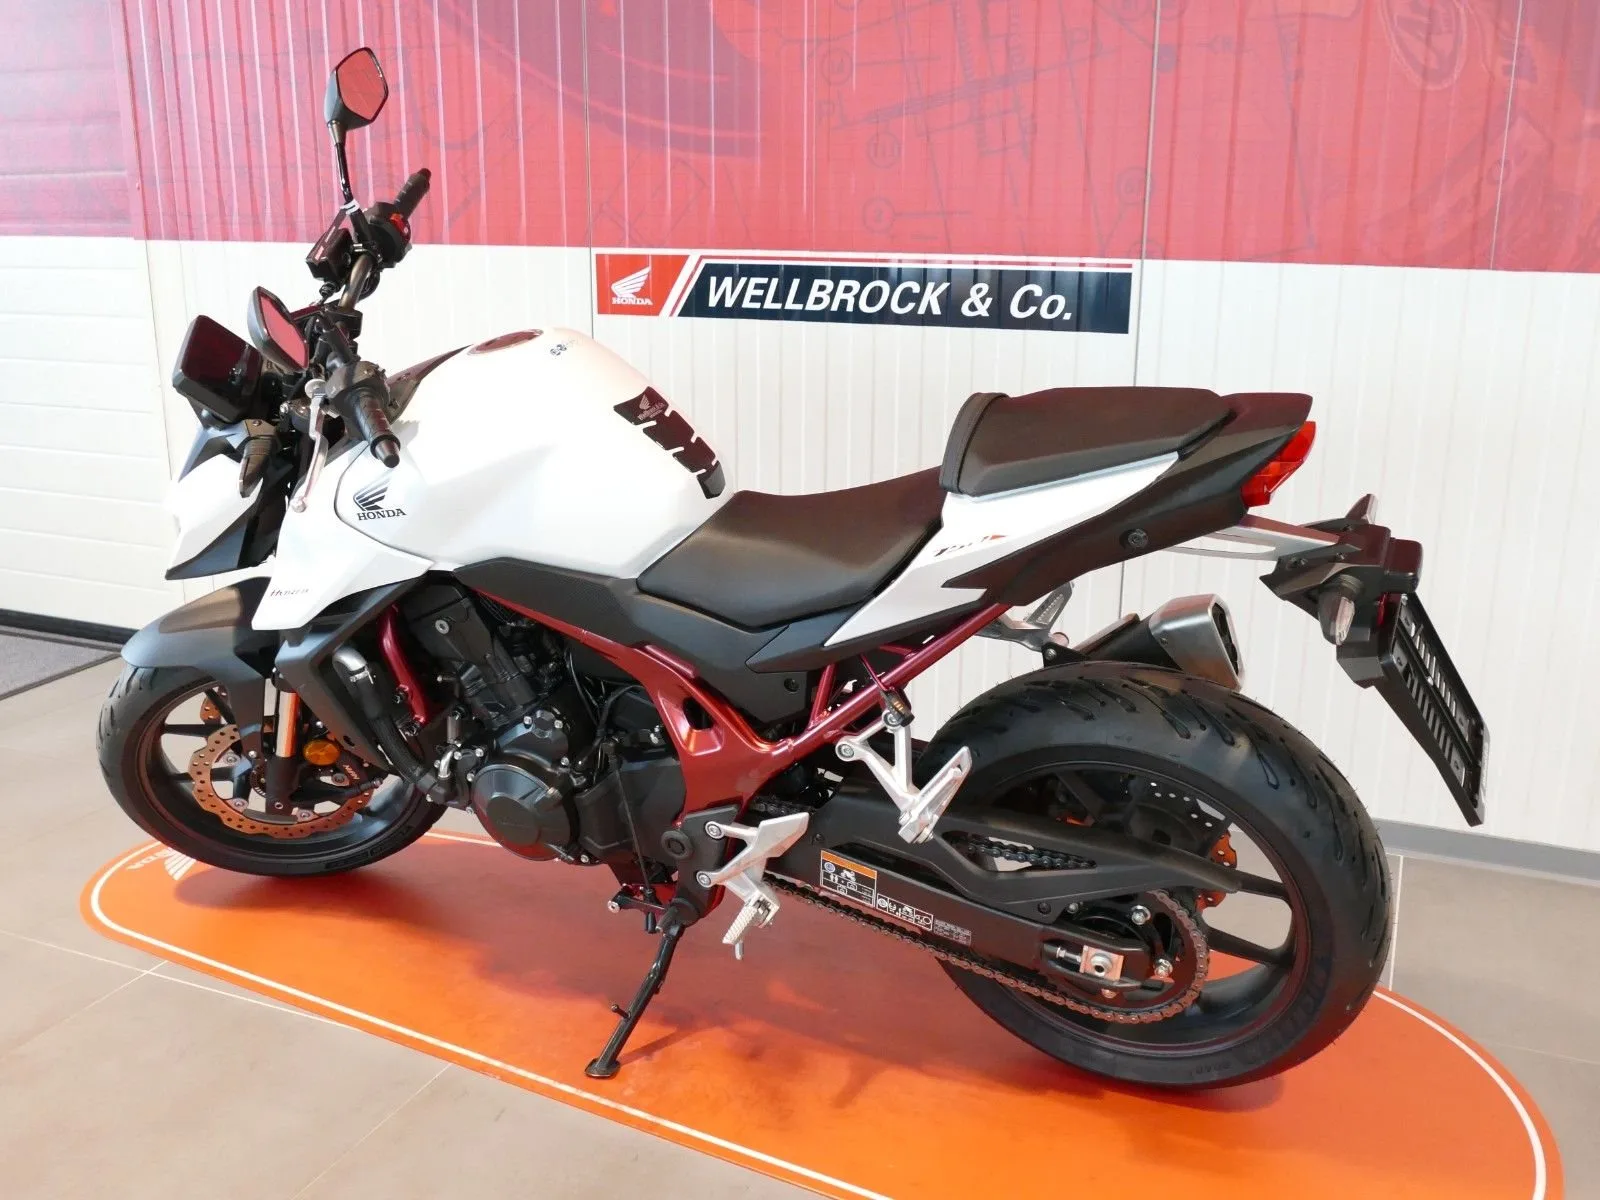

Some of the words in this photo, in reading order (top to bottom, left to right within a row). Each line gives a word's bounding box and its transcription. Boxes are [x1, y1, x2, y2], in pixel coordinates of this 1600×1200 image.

[611, 297, 653, 306] HONDA
[708, 276, 950, 315] WELLBROCK
[960, 282, 993, 317] &
[1009, 283, 1073, 321] Co.
[357, 508, 407, 520] HONDA
